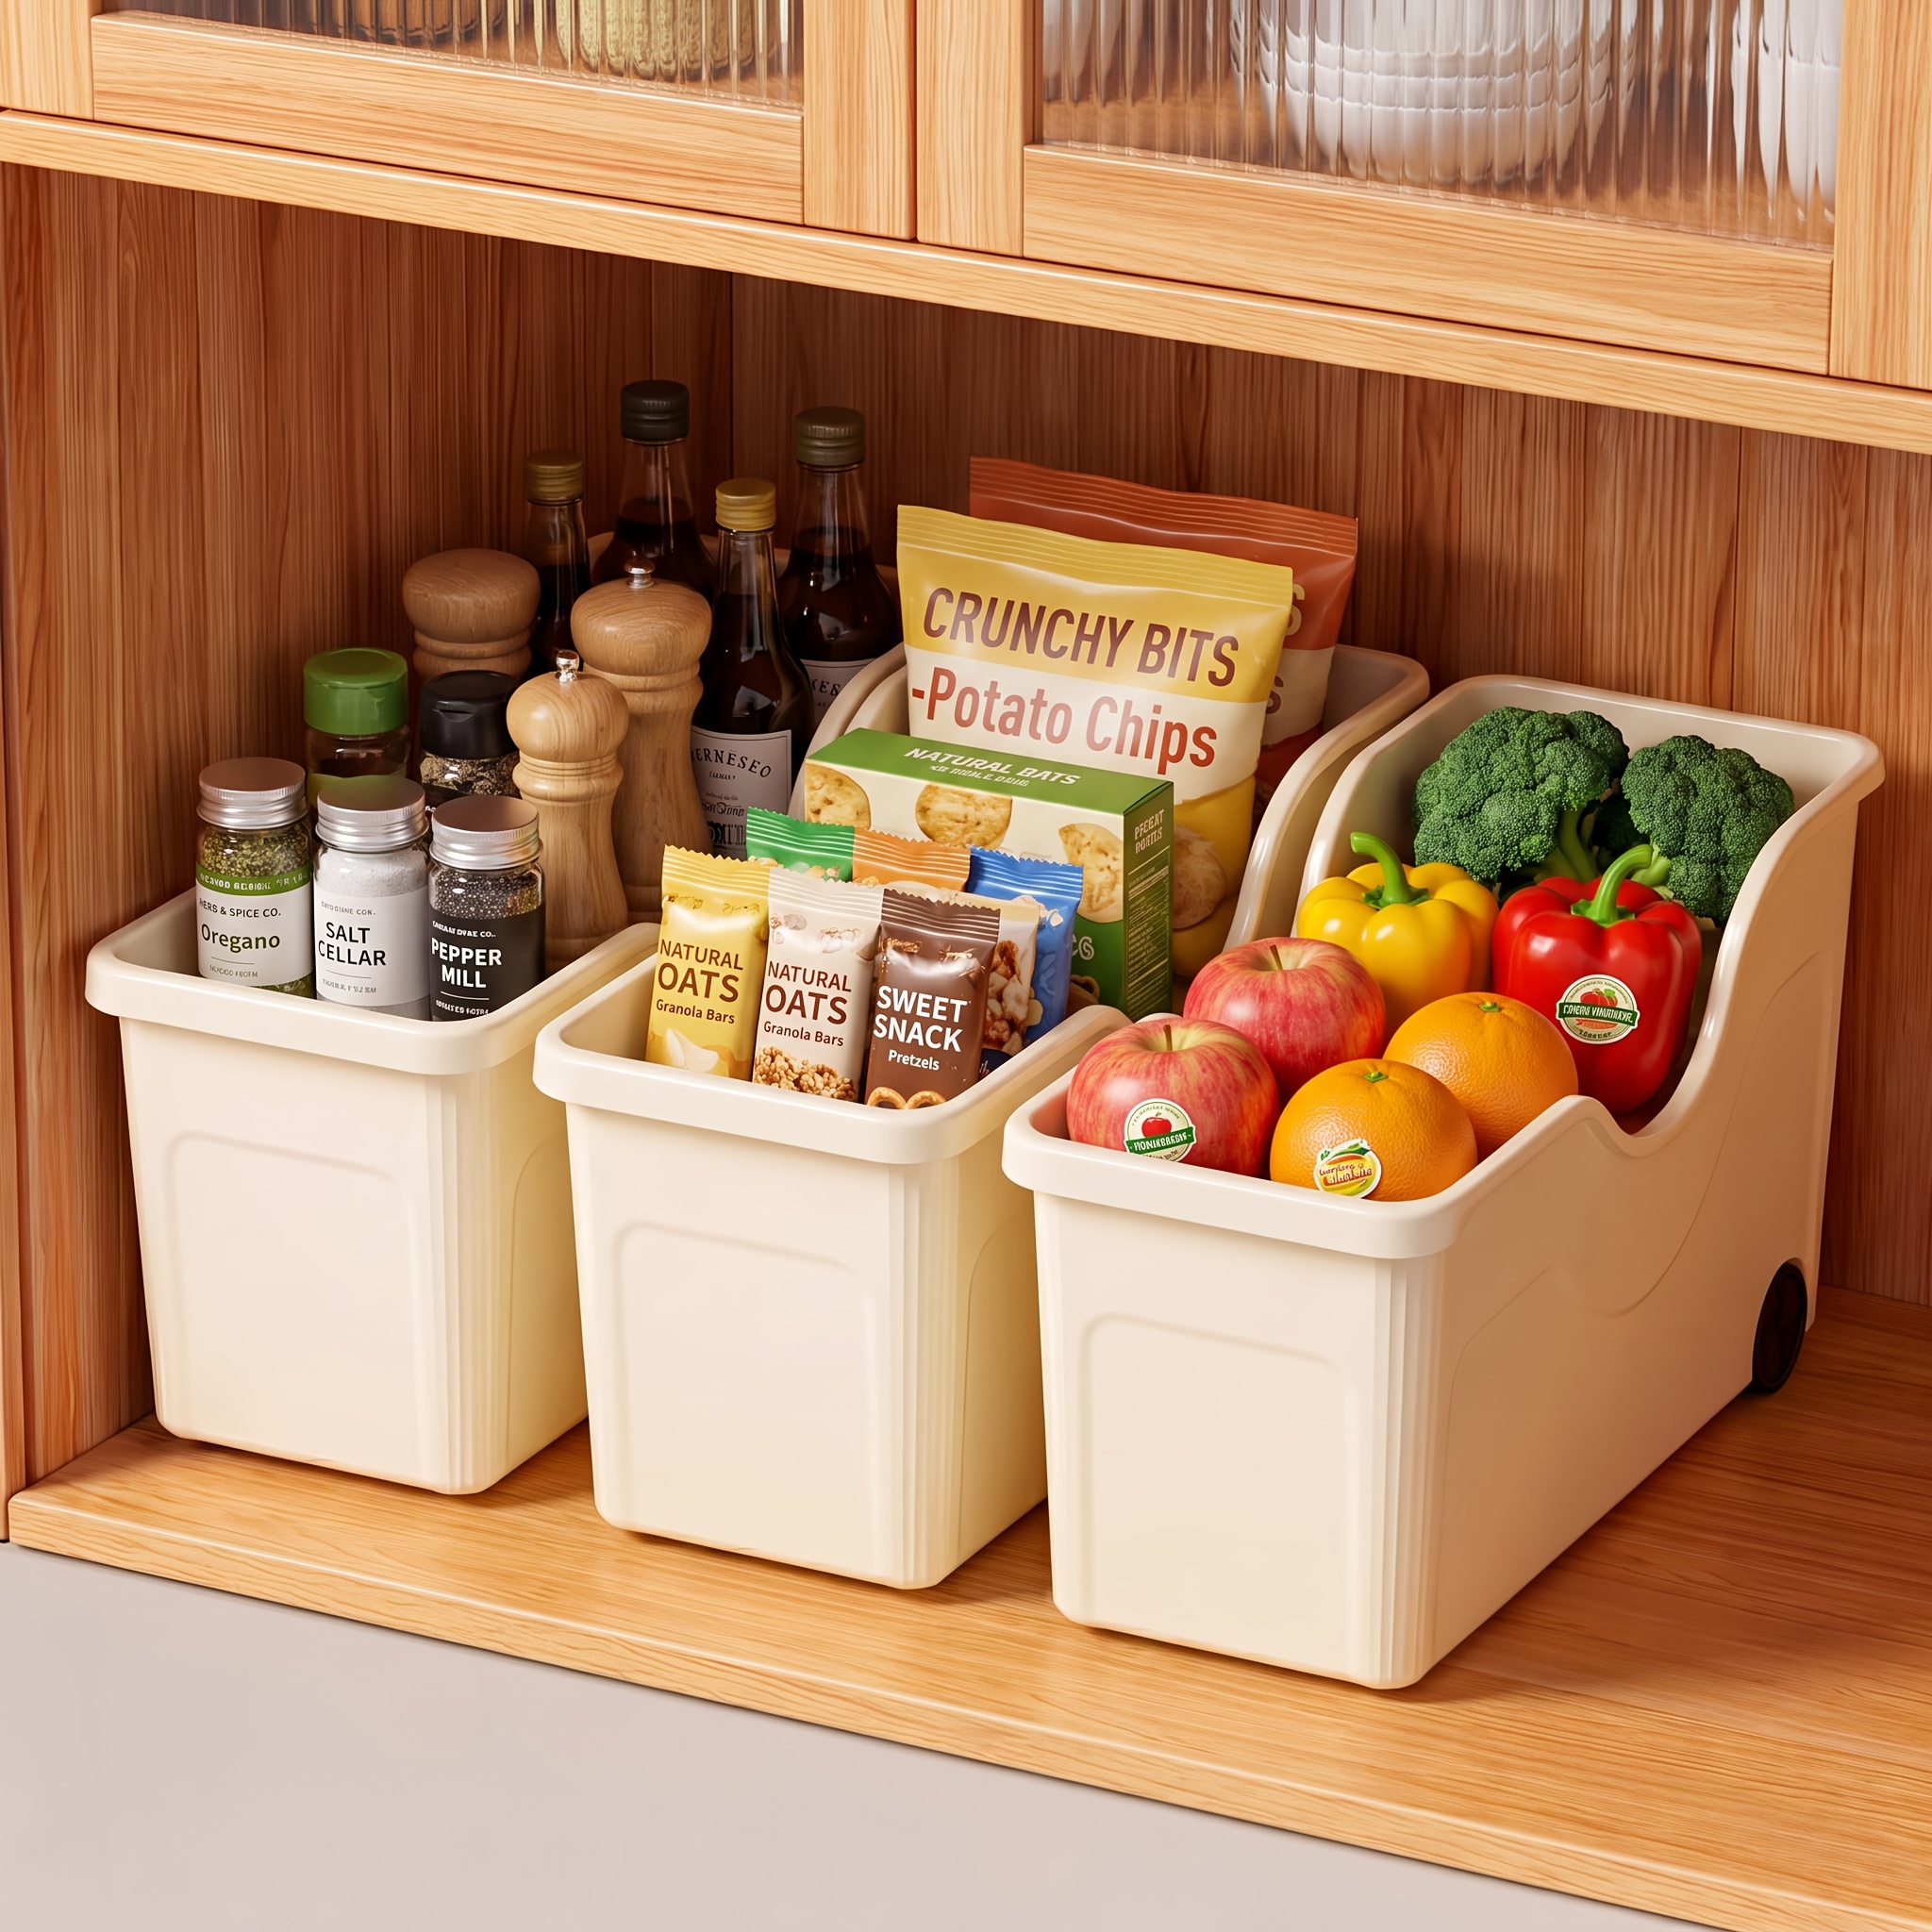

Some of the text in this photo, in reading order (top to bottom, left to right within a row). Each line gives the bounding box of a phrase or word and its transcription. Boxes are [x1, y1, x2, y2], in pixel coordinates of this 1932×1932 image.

[923, 587, 1240, 687] CRUNCHY BITS
[1086, 695, 1218, 774] Chips
[904, 748, 1013, 774] NATURAL
[1016, 767, 1081, 785] BATS
[220, 907, 226, 915] &
[229, 908, 259, 918] SPICE
[262, 908, 281, 918] CO.
[201, 924, 281, 954] Oregano
[325, 921, 371, 943] SALT
[318, 940, 387, 966] CELLAR
[431, 937, 502, 966] PEPPER
[659, 939, 743, 971] NATURAL
[441, 963, 487, 988] MILL
[658, 962, 740, 1003] OATS
[768, 960, 852, 992] NATURAL
[656, 999, 735, 1024] Granola Bars
[765, 984, 848, 1024] OATS
[876, 985, 968, 1023] SWEET
[763, 1021, 844, 1047] Granola Bars
[873, 1013, 963, 1052] SNACK
[888, 1049, 940, 1071] Pretzels
